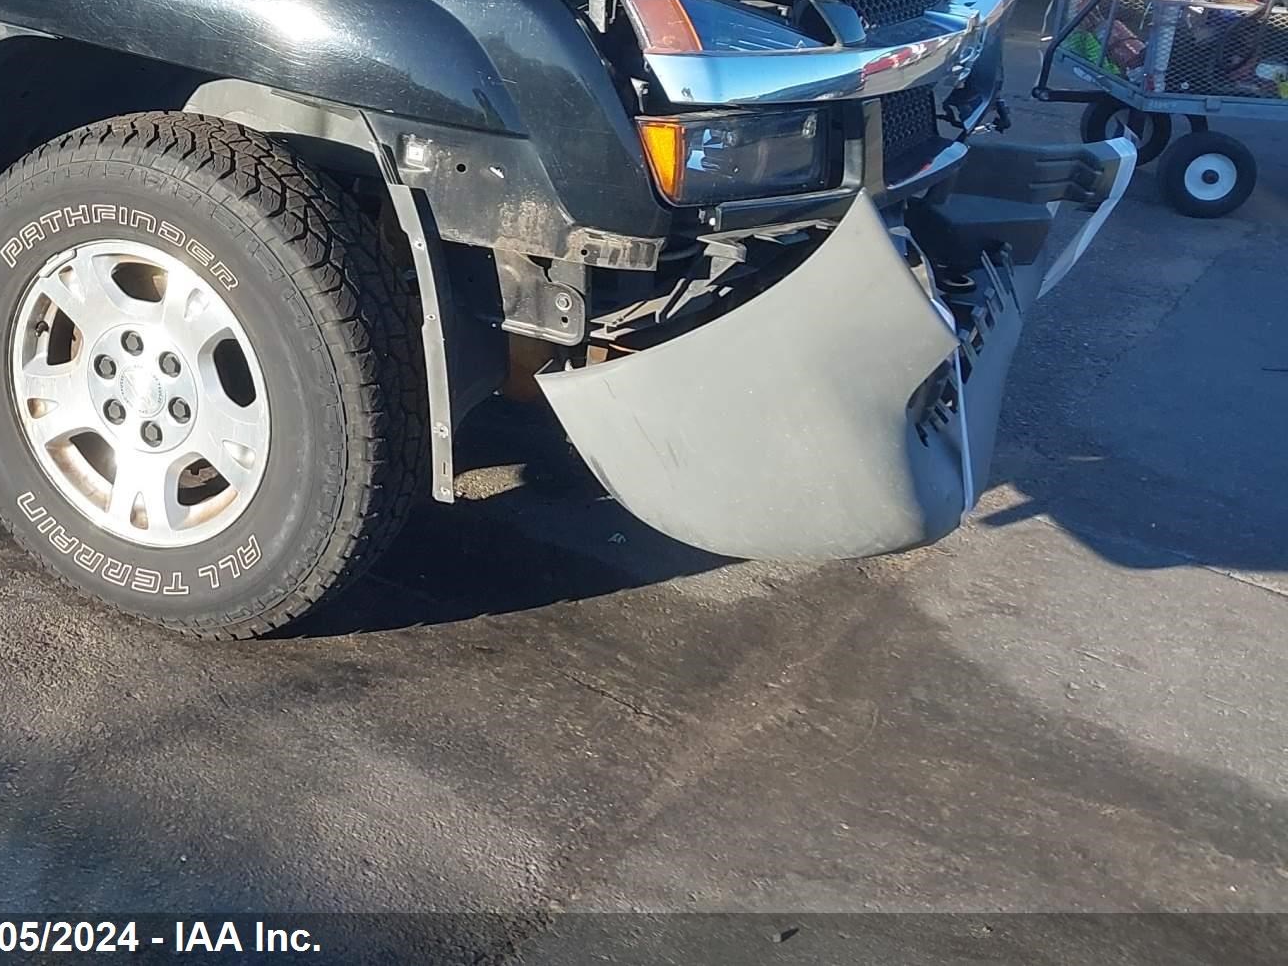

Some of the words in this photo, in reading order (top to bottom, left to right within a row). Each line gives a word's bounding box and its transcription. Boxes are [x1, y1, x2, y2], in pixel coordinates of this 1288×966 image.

[0, 203, 239, 292] PATHFINDER
[16, 491, 190, 596] TERRAIN
[197, 534, 263, 590] ALL
